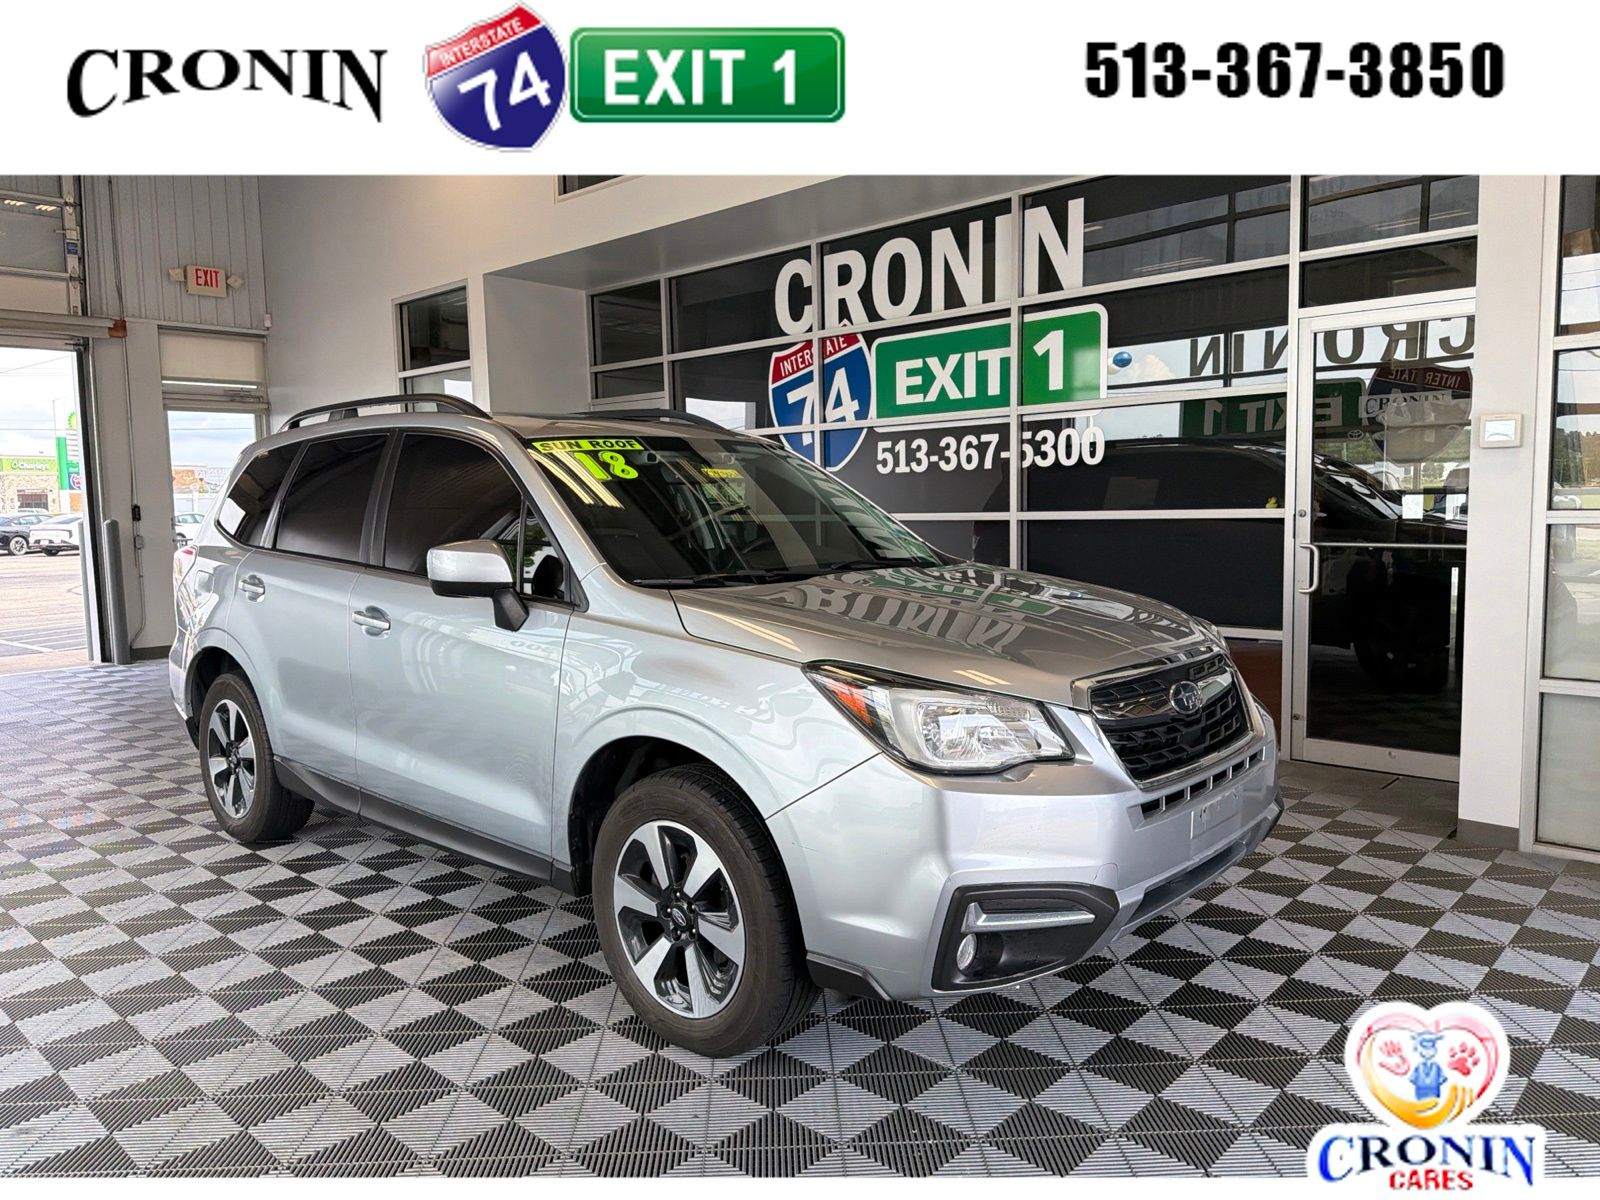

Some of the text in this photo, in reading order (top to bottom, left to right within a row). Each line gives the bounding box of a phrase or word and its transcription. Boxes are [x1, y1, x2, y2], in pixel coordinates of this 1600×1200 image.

[195, 267, 220, 289] EXIT
[775, 197, 1085, 336] CRONIN
[780, 336, 848, 377] INTERATE
[895, 330, 1065, 406] EXIT 1
[786, 367, 860, 447] 74
[540, 439, 637, 452] SUN ROOF
[574, 451, 639, 480] 18
[876, 426, 1106, 475] 513-367-5300
